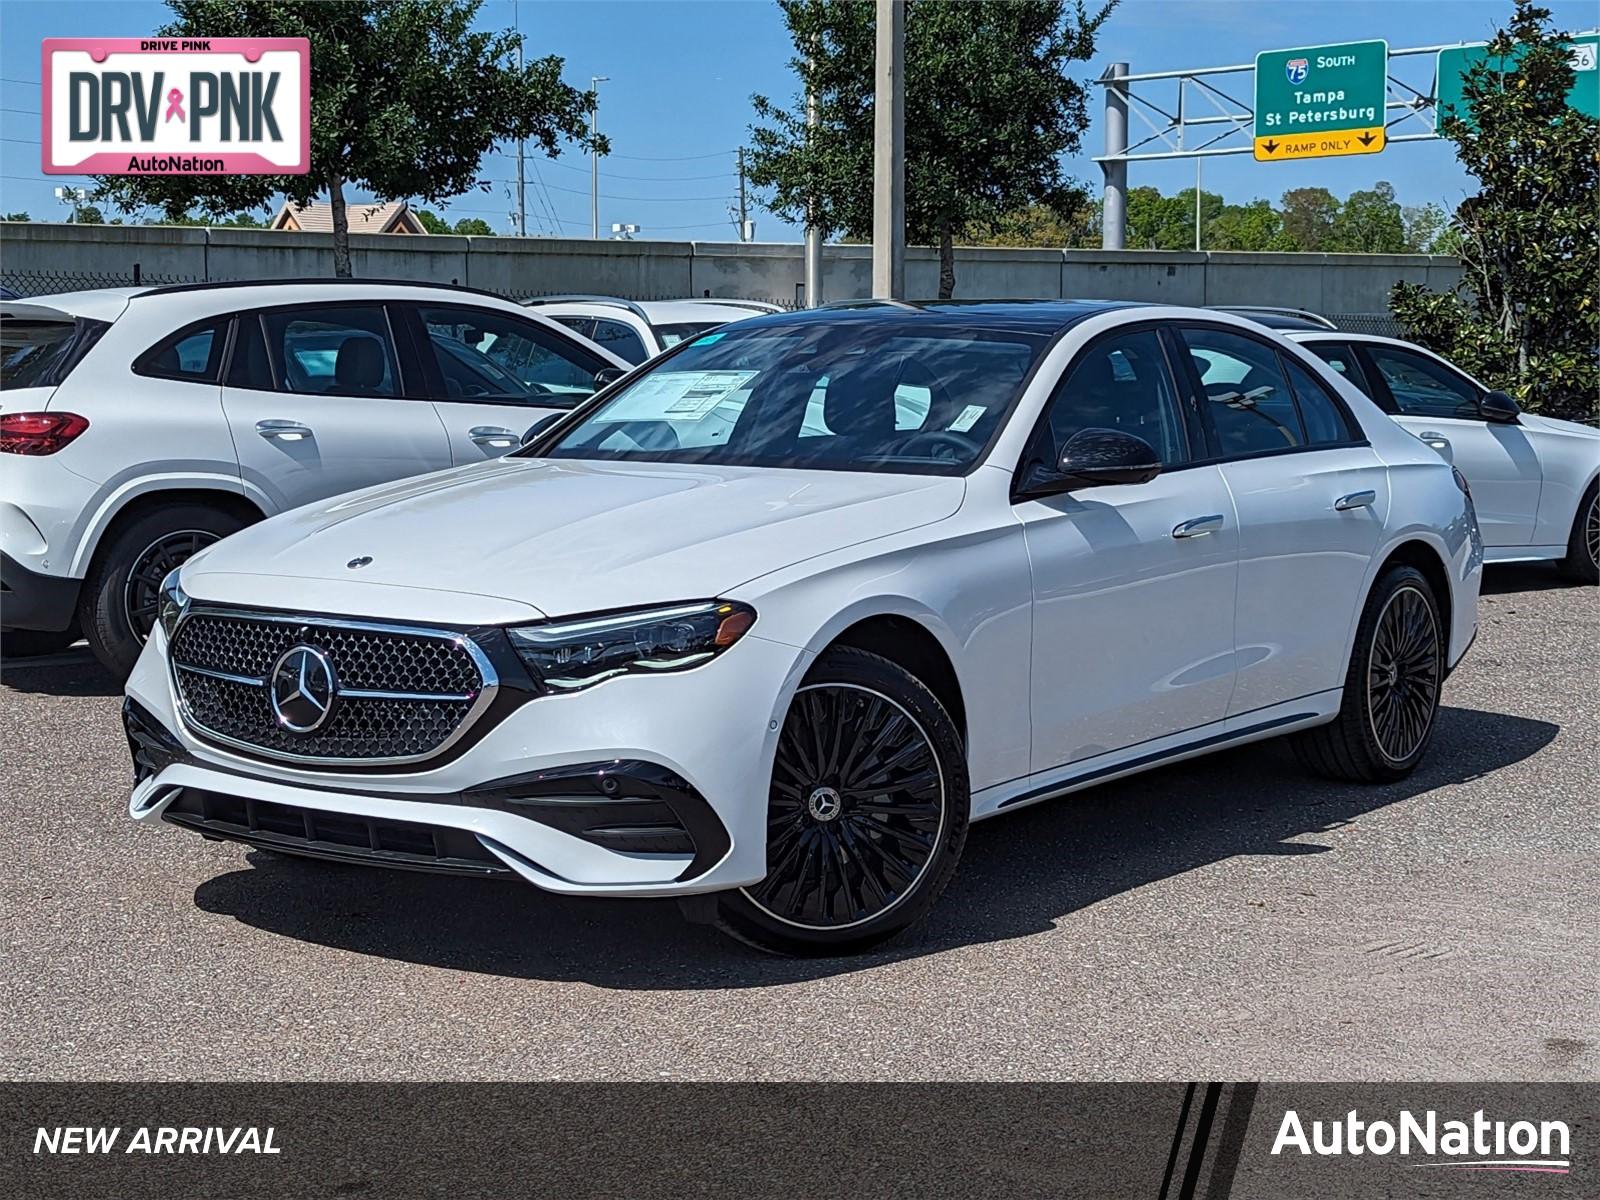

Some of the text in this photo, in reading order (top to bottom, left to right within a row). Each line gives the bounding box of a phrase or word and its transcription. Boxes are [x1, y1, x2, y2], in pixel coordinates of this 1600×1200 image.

[1288, 65, 1307, 80] 75
[1294, 90, 1345, 104] Tampa
[1265, 107, 1375, 126] St Petersburg
[1285, 140, 1352, 153] RAMP ONLY
